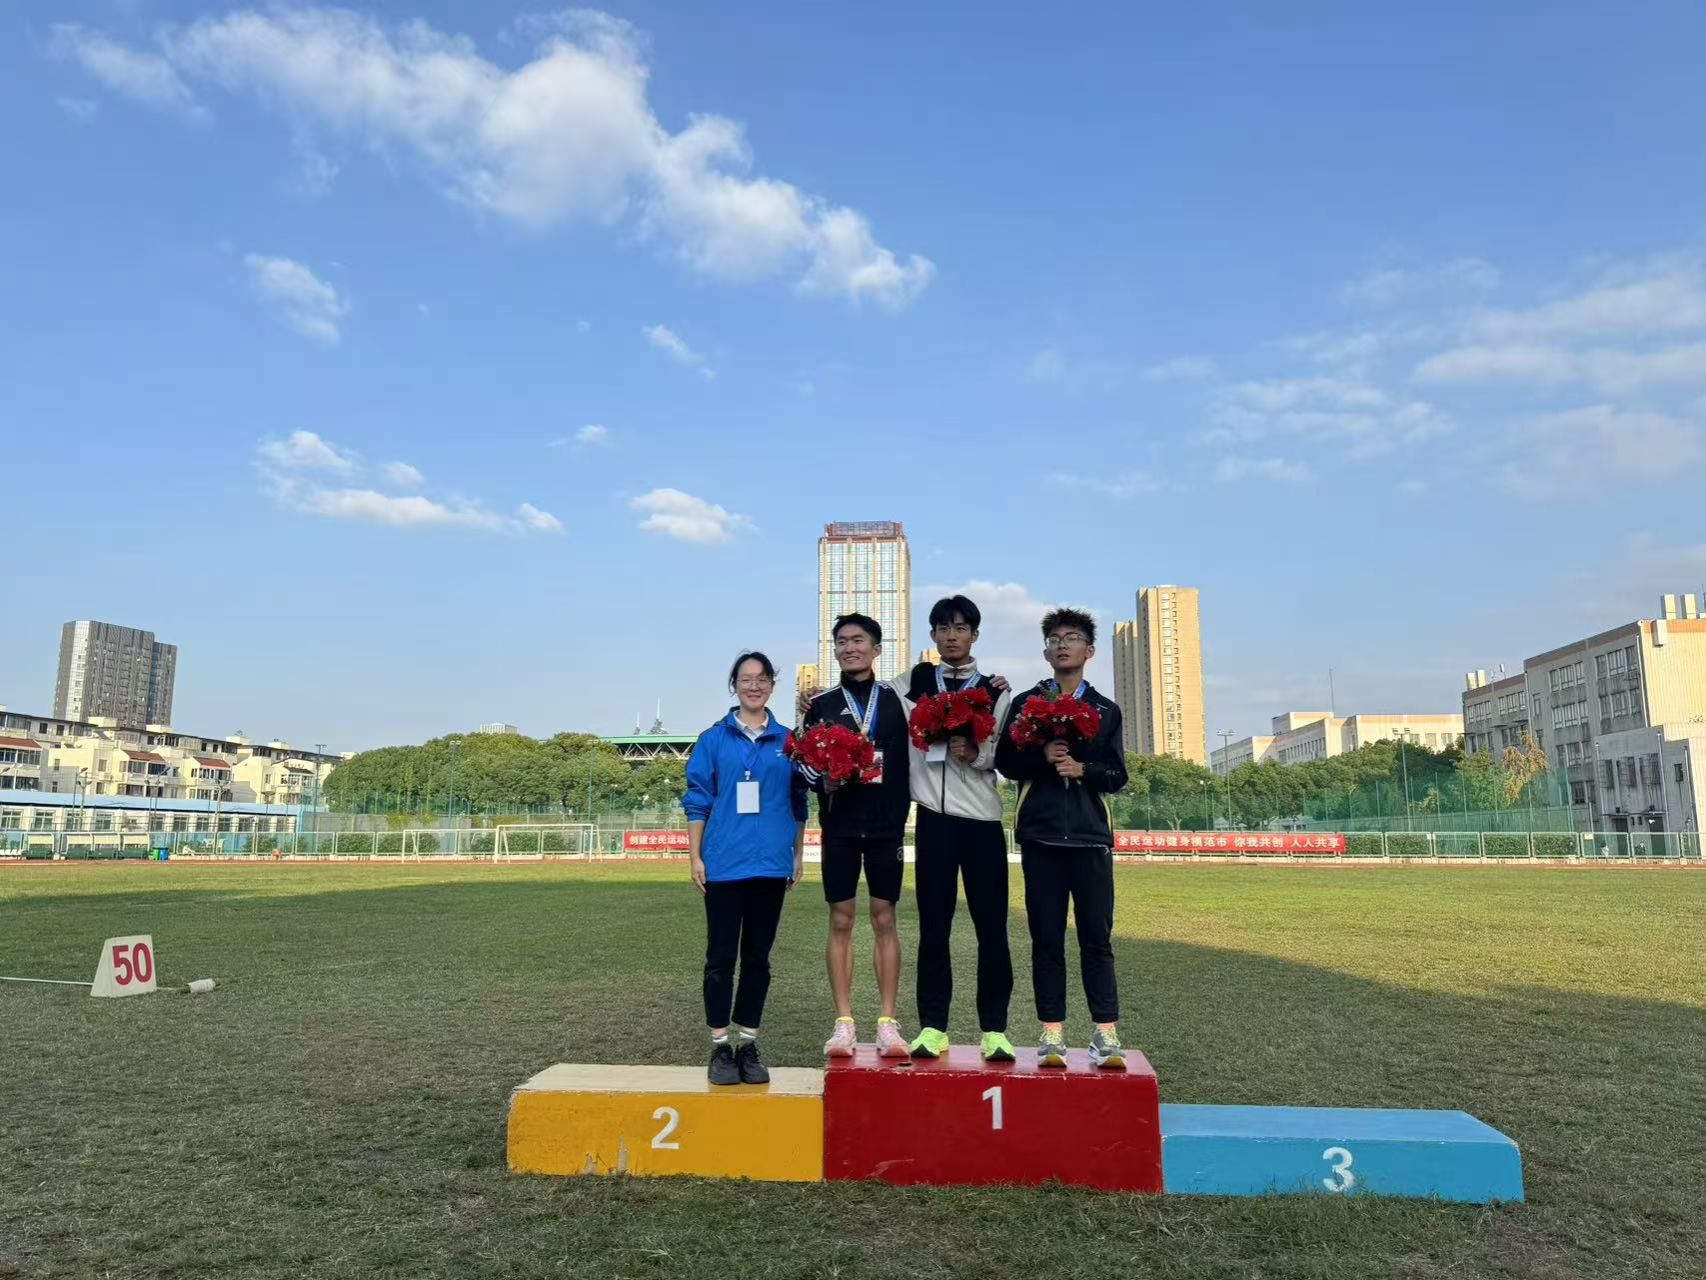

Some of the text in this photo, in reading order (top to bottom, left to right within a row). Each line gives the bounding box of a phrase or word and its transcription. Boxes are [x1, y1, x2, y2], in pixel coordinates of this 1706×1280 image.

[1290, 837, 1340, 848] 人人共享
[112, 942, 153, 986] 50
[651, 1106, 680, 1149] 2
[982, 1086, 1003, 1129] 1
[1322, 1146, 1357, 1193] 3
